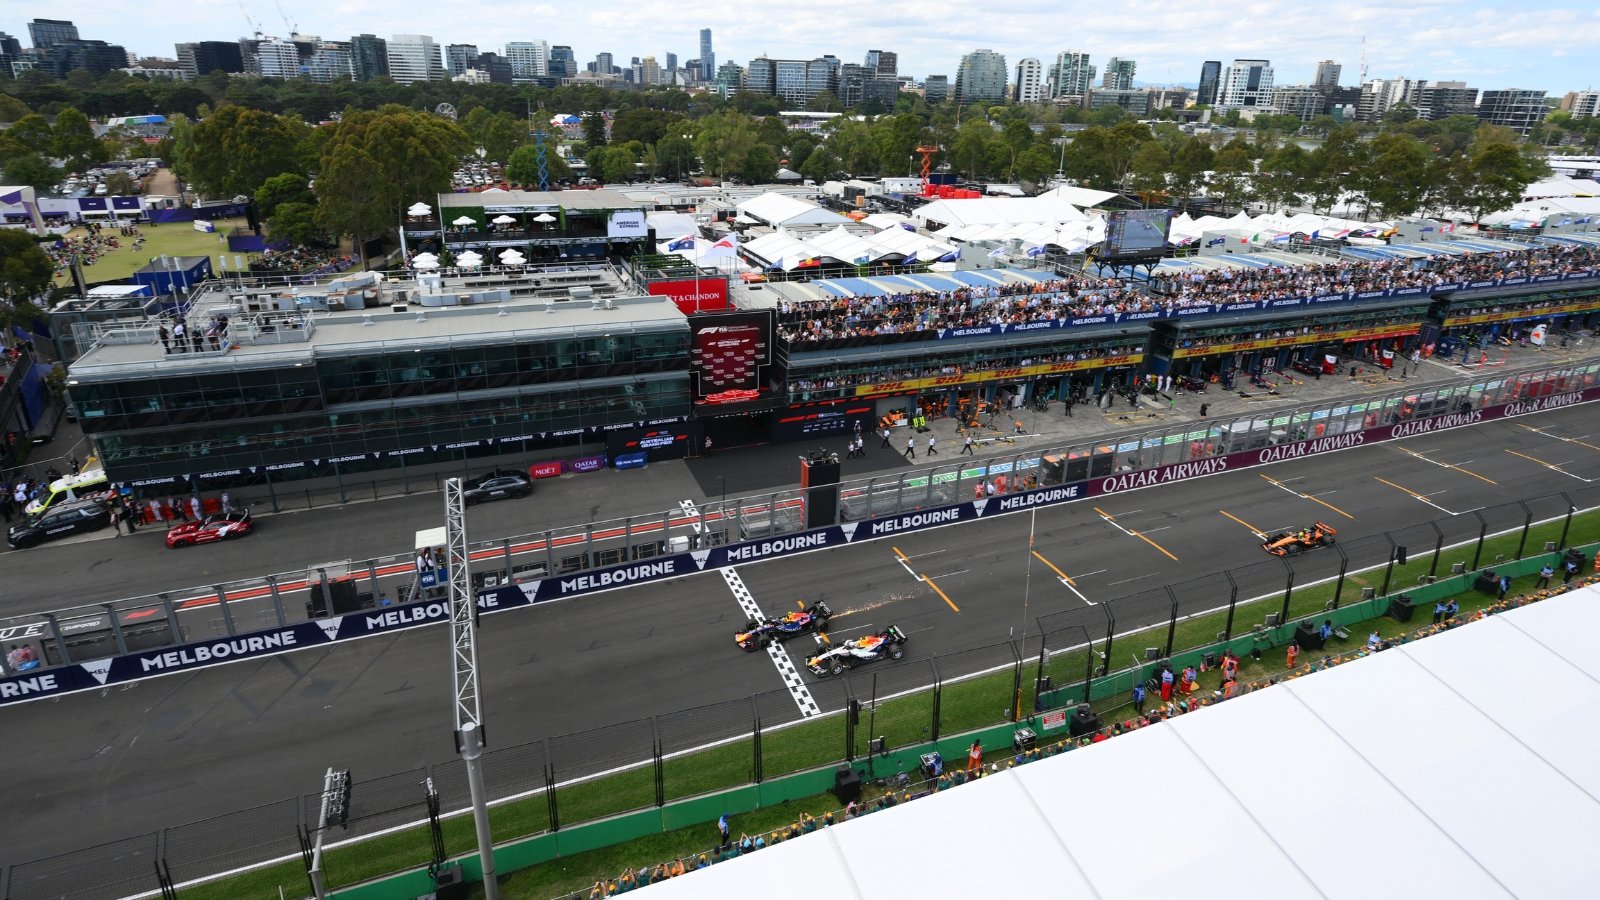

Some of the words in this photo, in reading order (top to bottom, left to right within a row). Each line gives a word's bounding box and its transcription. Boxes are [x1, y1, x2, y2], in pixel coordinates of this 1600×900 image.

[685, 292, 720, 301] CHANDON
[1178, 307, 1209, 315] MELBOURNE
[1072, 317, 1107, 325] MELBOURNE
[1014, 322, 1051, 330] MELBOURNE
[953, 327, 992, 336] MELBOURNE
[1185, 348, 1211, 356] DHL
[1103, 356, 1130, 364] DHL
[1050, 363, 1078, 371] DHL
[994, 369, 1023, 378] DHL
[935, 375, 966, 384] DHL
[872, 382, 905, 392] DHL
[1504, 400, 1538, 416] QATAR
[1541, 391, 1584, 410] AIRWAYS
[1392, 418, 1433, 438] QATAR
[1435, 410, 1482, 430] AIRWAYS
[553, 428, 584, 436] MELBOURNE
[388, 448, 424, 456] MELBOURNE
[1259, 444, 1307, 463] QATAR
[1310, 432, 1364, 454] AIRWAYS
[328, 454, 365, 463] MELBOURNE
[266, 462, 304, 471] MELBOURNE
[575, 460, 598, 468] QATAR
[200, 470, 240, 478] MELBOURNE
[536, 467, 556, 475] MOËT
[1102, 470, 1158, 492] QATAR
[1161, 456, 1226, 484] AIRWAYS
[132, 477, 175, 486] MELBOURNE
[1000, 486, 1078, 510] MELBOURNE
[872, 508, 960, 534] MELBOURNE
[728, 532, 826, 562] MELBOURNE
[561, 561, 674, 593] MELBOURNE
[366, 593, 498, 630] MELBONE
[141, 630, 296, 672] MELBOURNE
[90, 668, 109, 676] MEL
